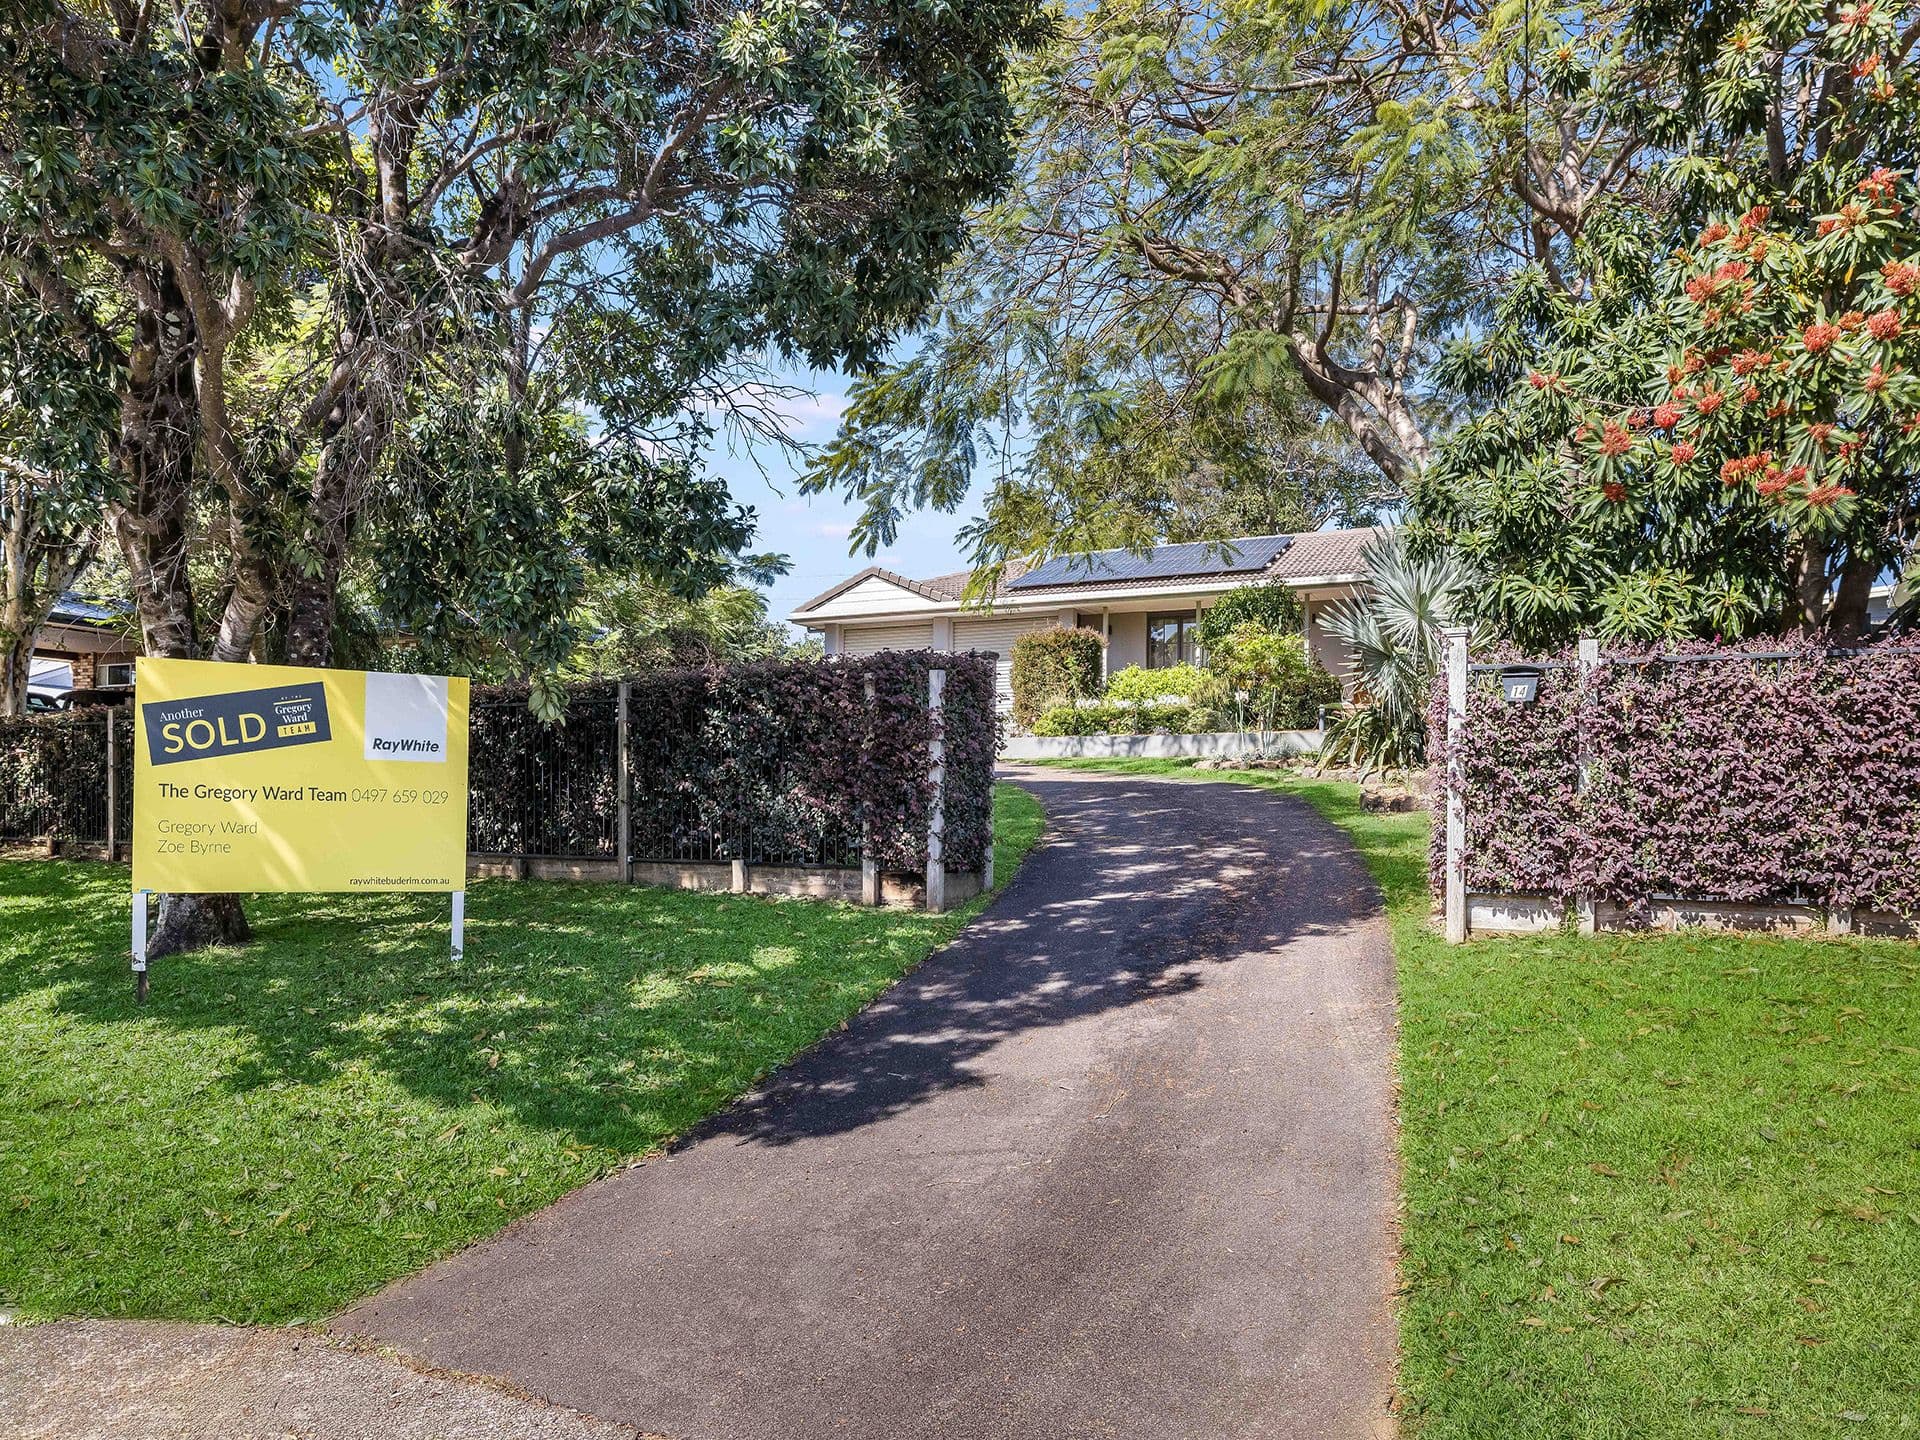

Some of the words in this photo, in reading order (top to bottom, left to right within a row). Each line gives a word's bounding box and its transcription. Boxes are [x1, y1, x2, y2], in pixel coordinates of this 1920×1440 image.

[1514, 686, 1526, 697] 14
[160, 708, 204, 722] Another
[275, 703, 312, 715] Gregory
[282, 712, 308, 723] Ward
[162, 713, 267, 754] SOLD
[283, 724, 311, 735] TEAM
[372, 738, 440, 753] RayWhite
[158, 783, 189, 798] The
[194, 784, 258, 802] Gregory
[262, 786, 304, 800] Ward
[308, 787, 347, 802] Team
[351, 788, 388, 802] 0497
[392, 789, 418, 803] 659
[422, 790, 449, 804] 029
[158, 819, 216, 836] Gregory
[220, 821, 258, 834] Ward
[157, 839, 185, 853] Zoe
[190, 840, 231, 855] Byrne
[349, 876, 450, 886] raywhitebuderim.com.au
